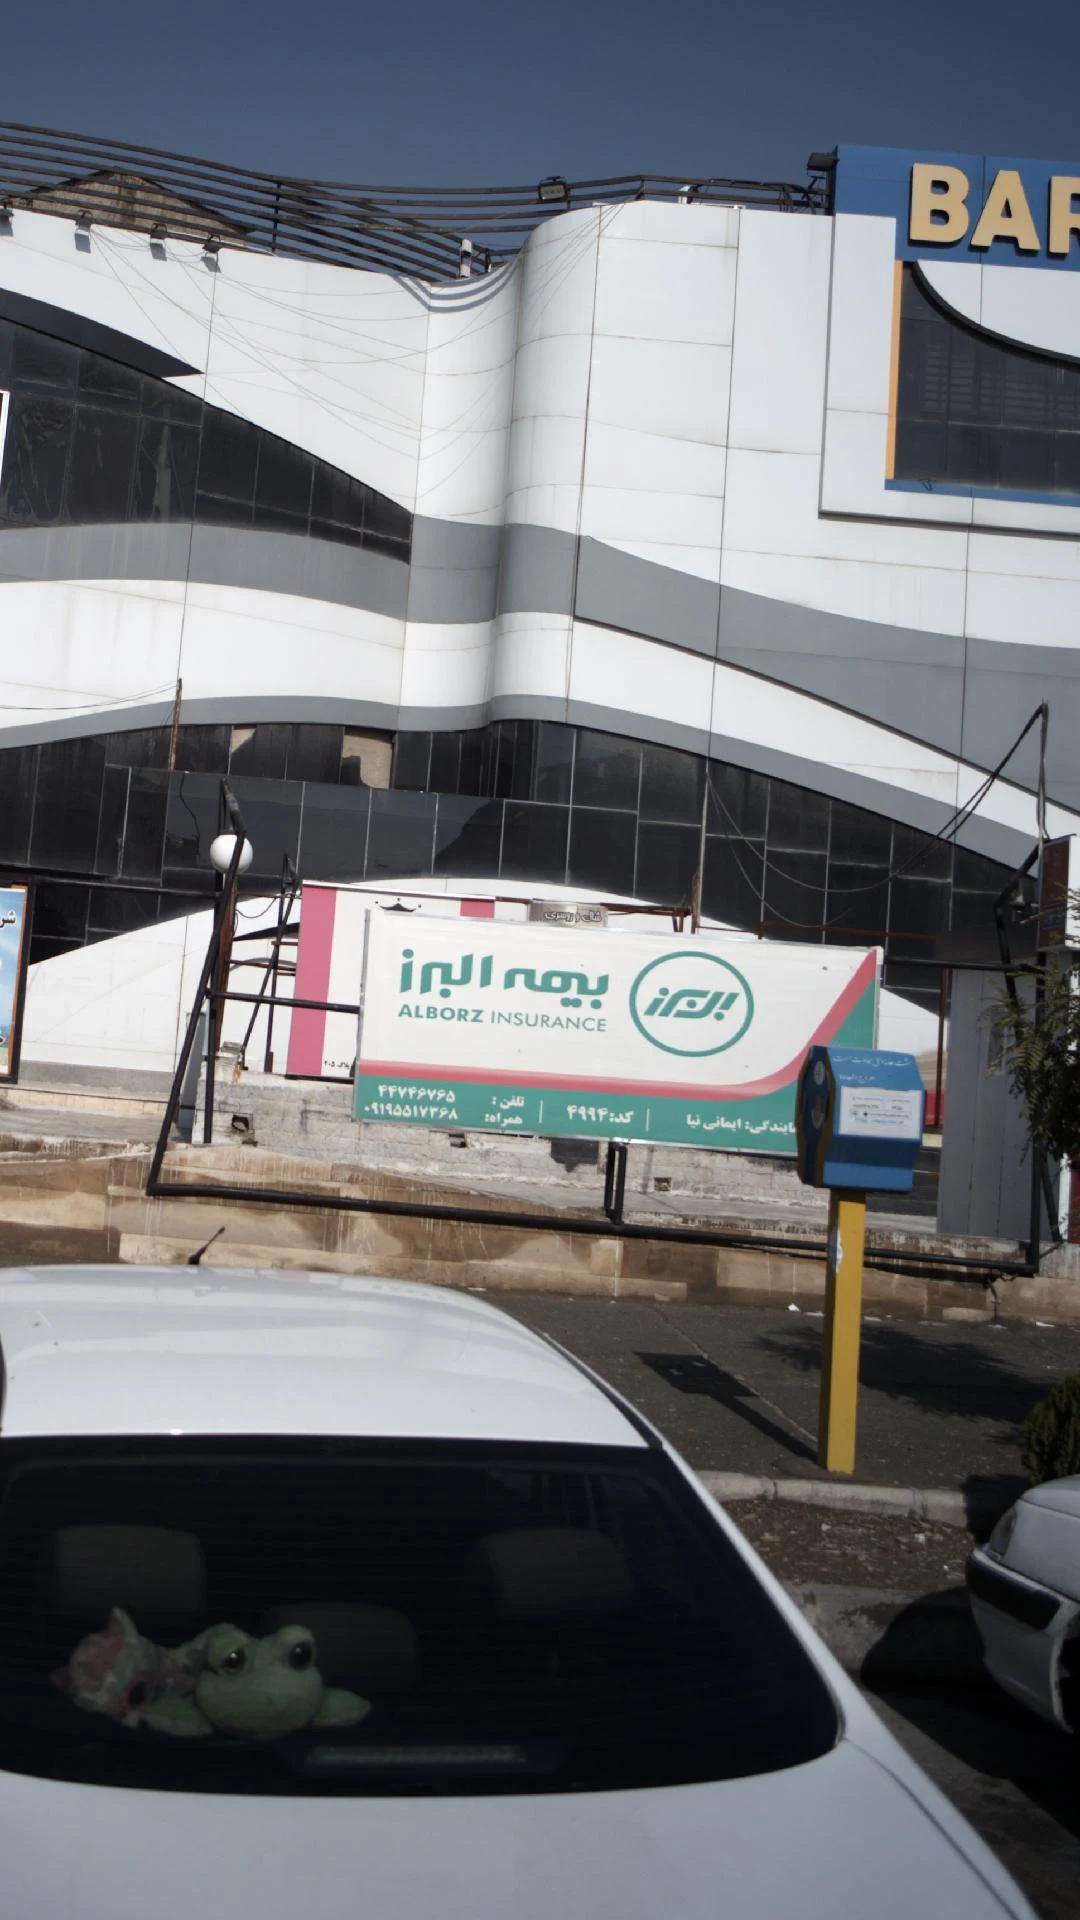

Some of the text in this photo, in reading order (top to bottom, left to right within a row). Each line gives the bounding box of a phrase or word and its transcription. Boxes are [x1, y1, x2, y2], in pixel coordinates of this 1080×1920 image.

[400, 948, 609, 1009] بیمه البرز
[398, 1004, 608, 1032] ALBORZ INSURANCE
[378, 1084, 456, 1103] ۴۴۷۴۶۷۶۵
[686, 1113, 701, 1128] نیا
[702, 1115, 742, 1131] ایمانی
